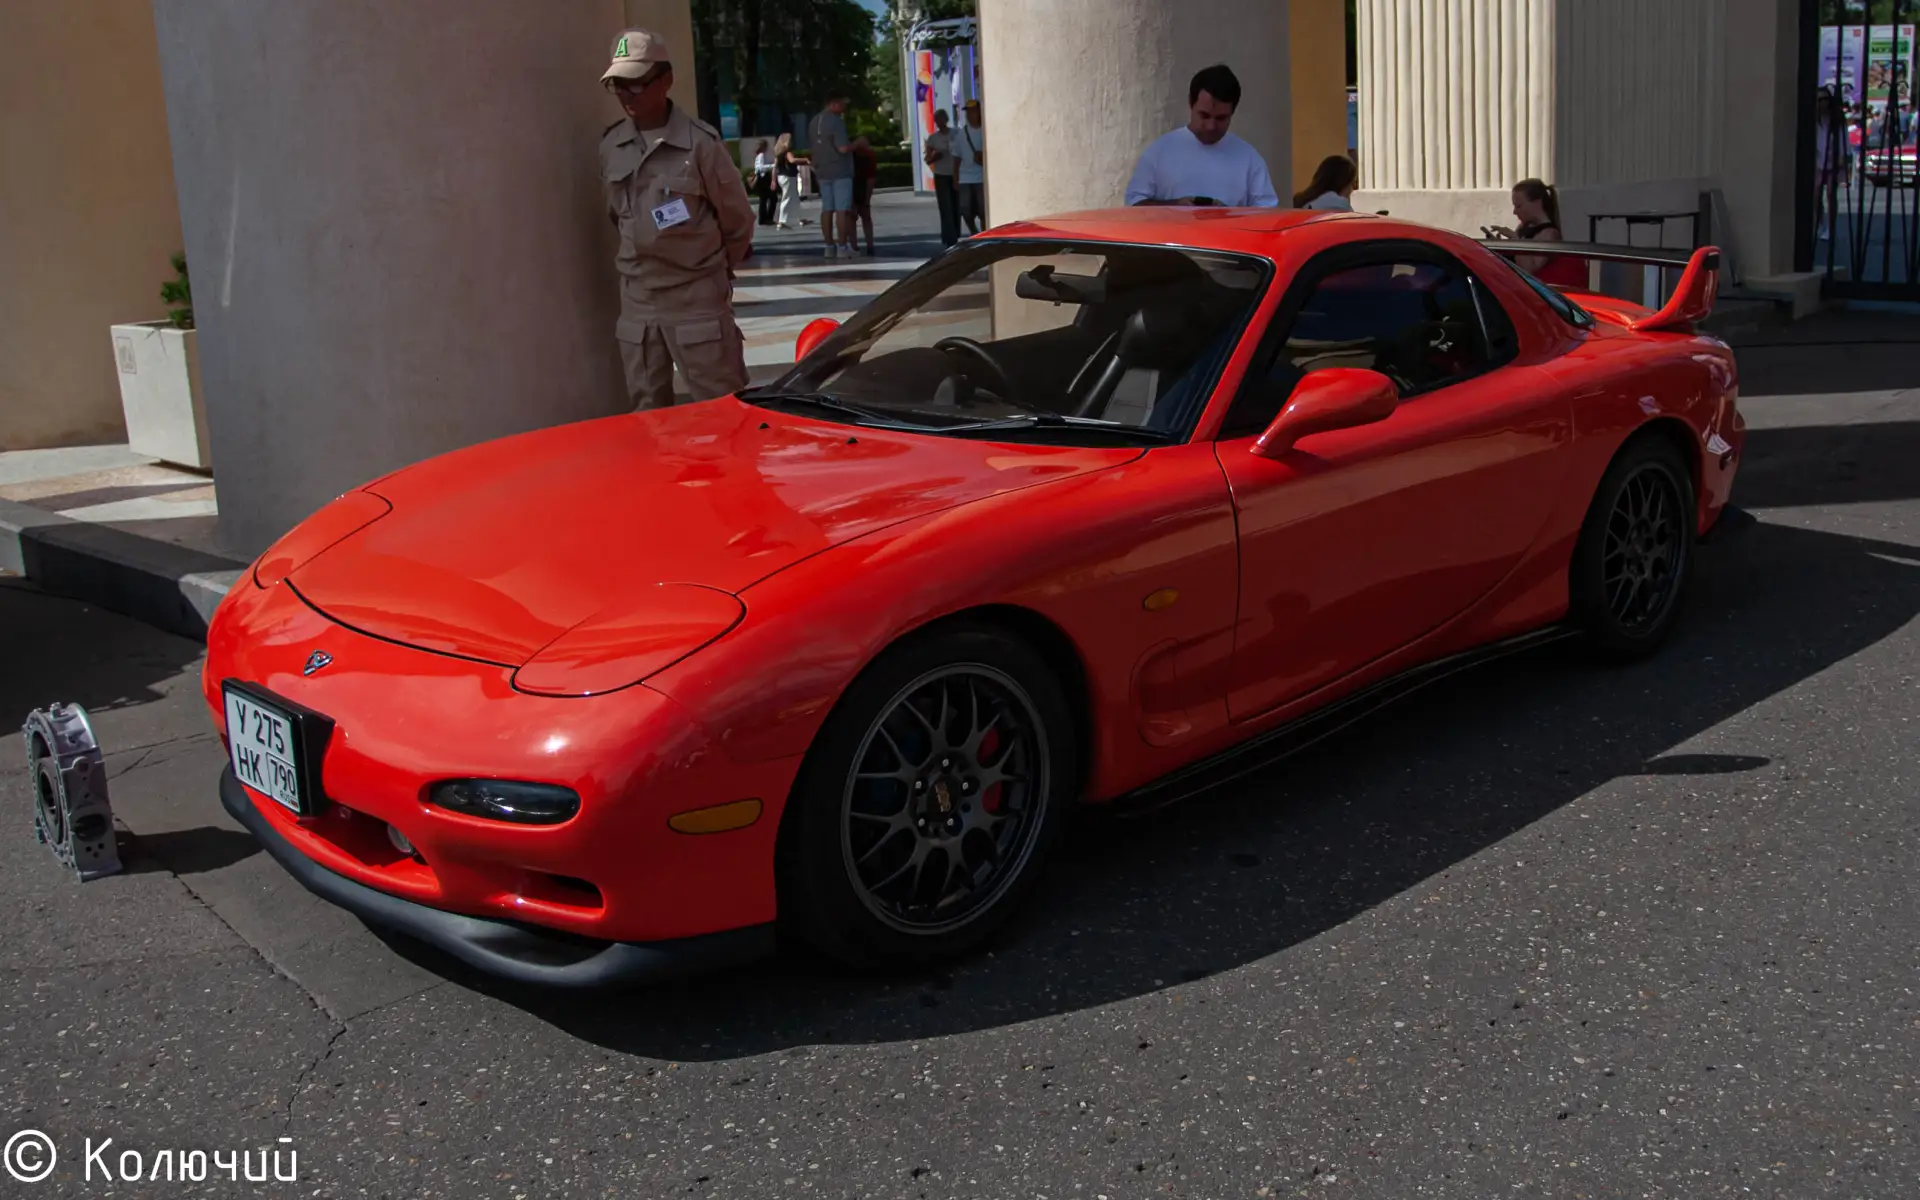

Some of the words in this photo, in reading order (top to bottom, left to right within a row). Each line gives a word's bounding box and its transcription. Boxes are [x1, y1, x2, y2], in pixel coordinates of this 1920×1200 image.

[614, 36, 629, 57] A
[253, 709, 285, 755] 275
[270, 758, 297, 796] 790
